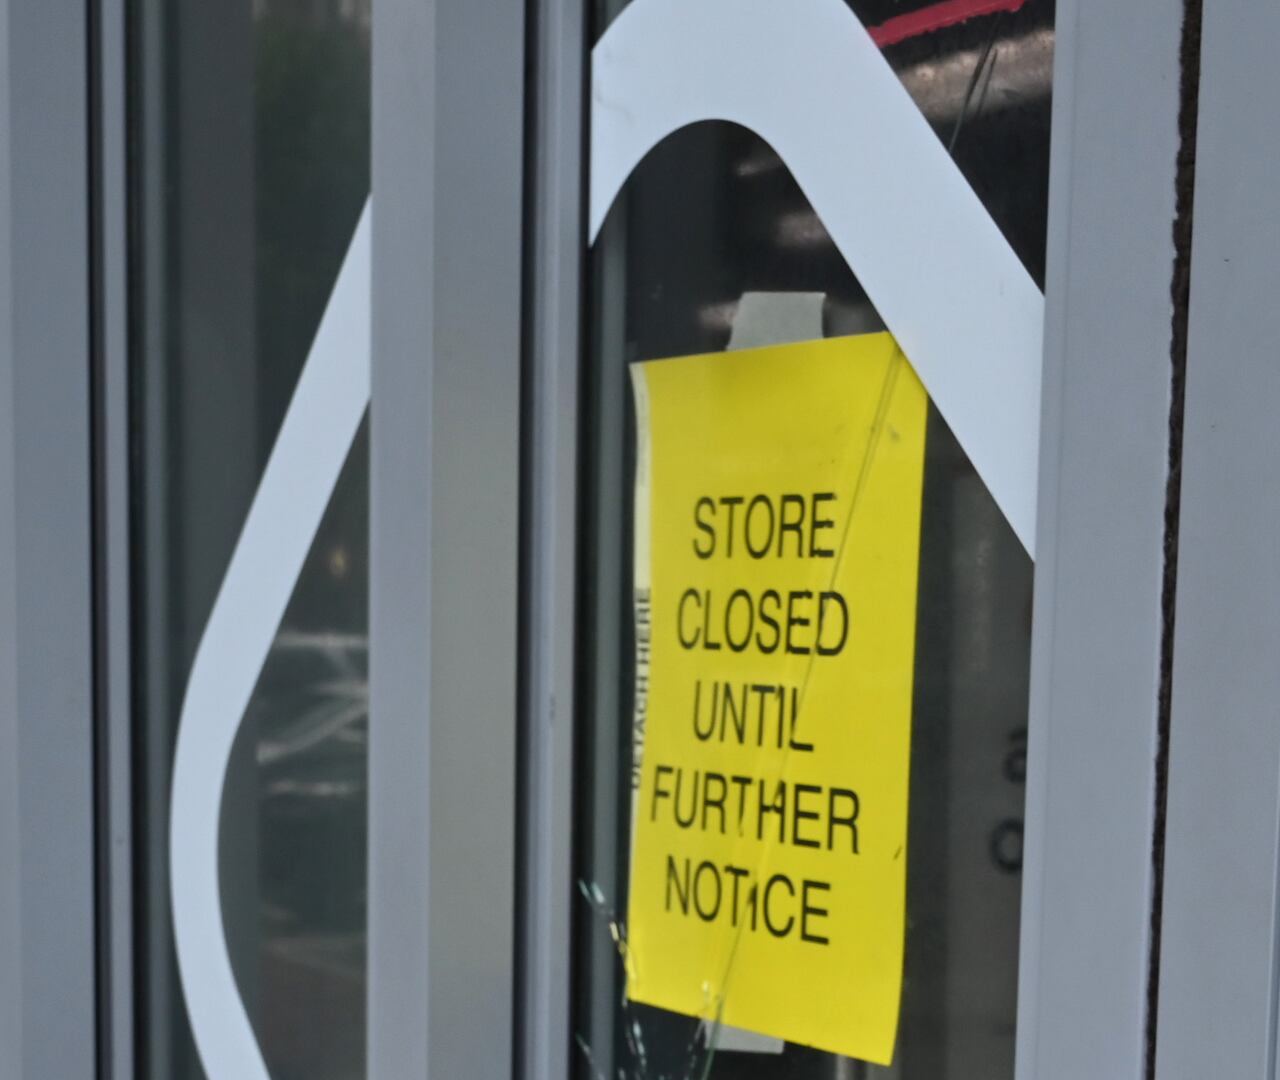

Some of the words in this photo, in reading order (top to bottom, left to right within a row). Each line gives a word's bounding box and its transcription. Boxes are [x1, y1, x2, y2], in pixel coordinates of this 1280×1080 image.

[692, 492, 837, 560] STORE
[676, 588, 849, 656] CLOSED
[693, 680, 814, 752] UNTIL
[651, 765, 860, 855] FURTHER
[665, 854, 831, 945] NOTICE
